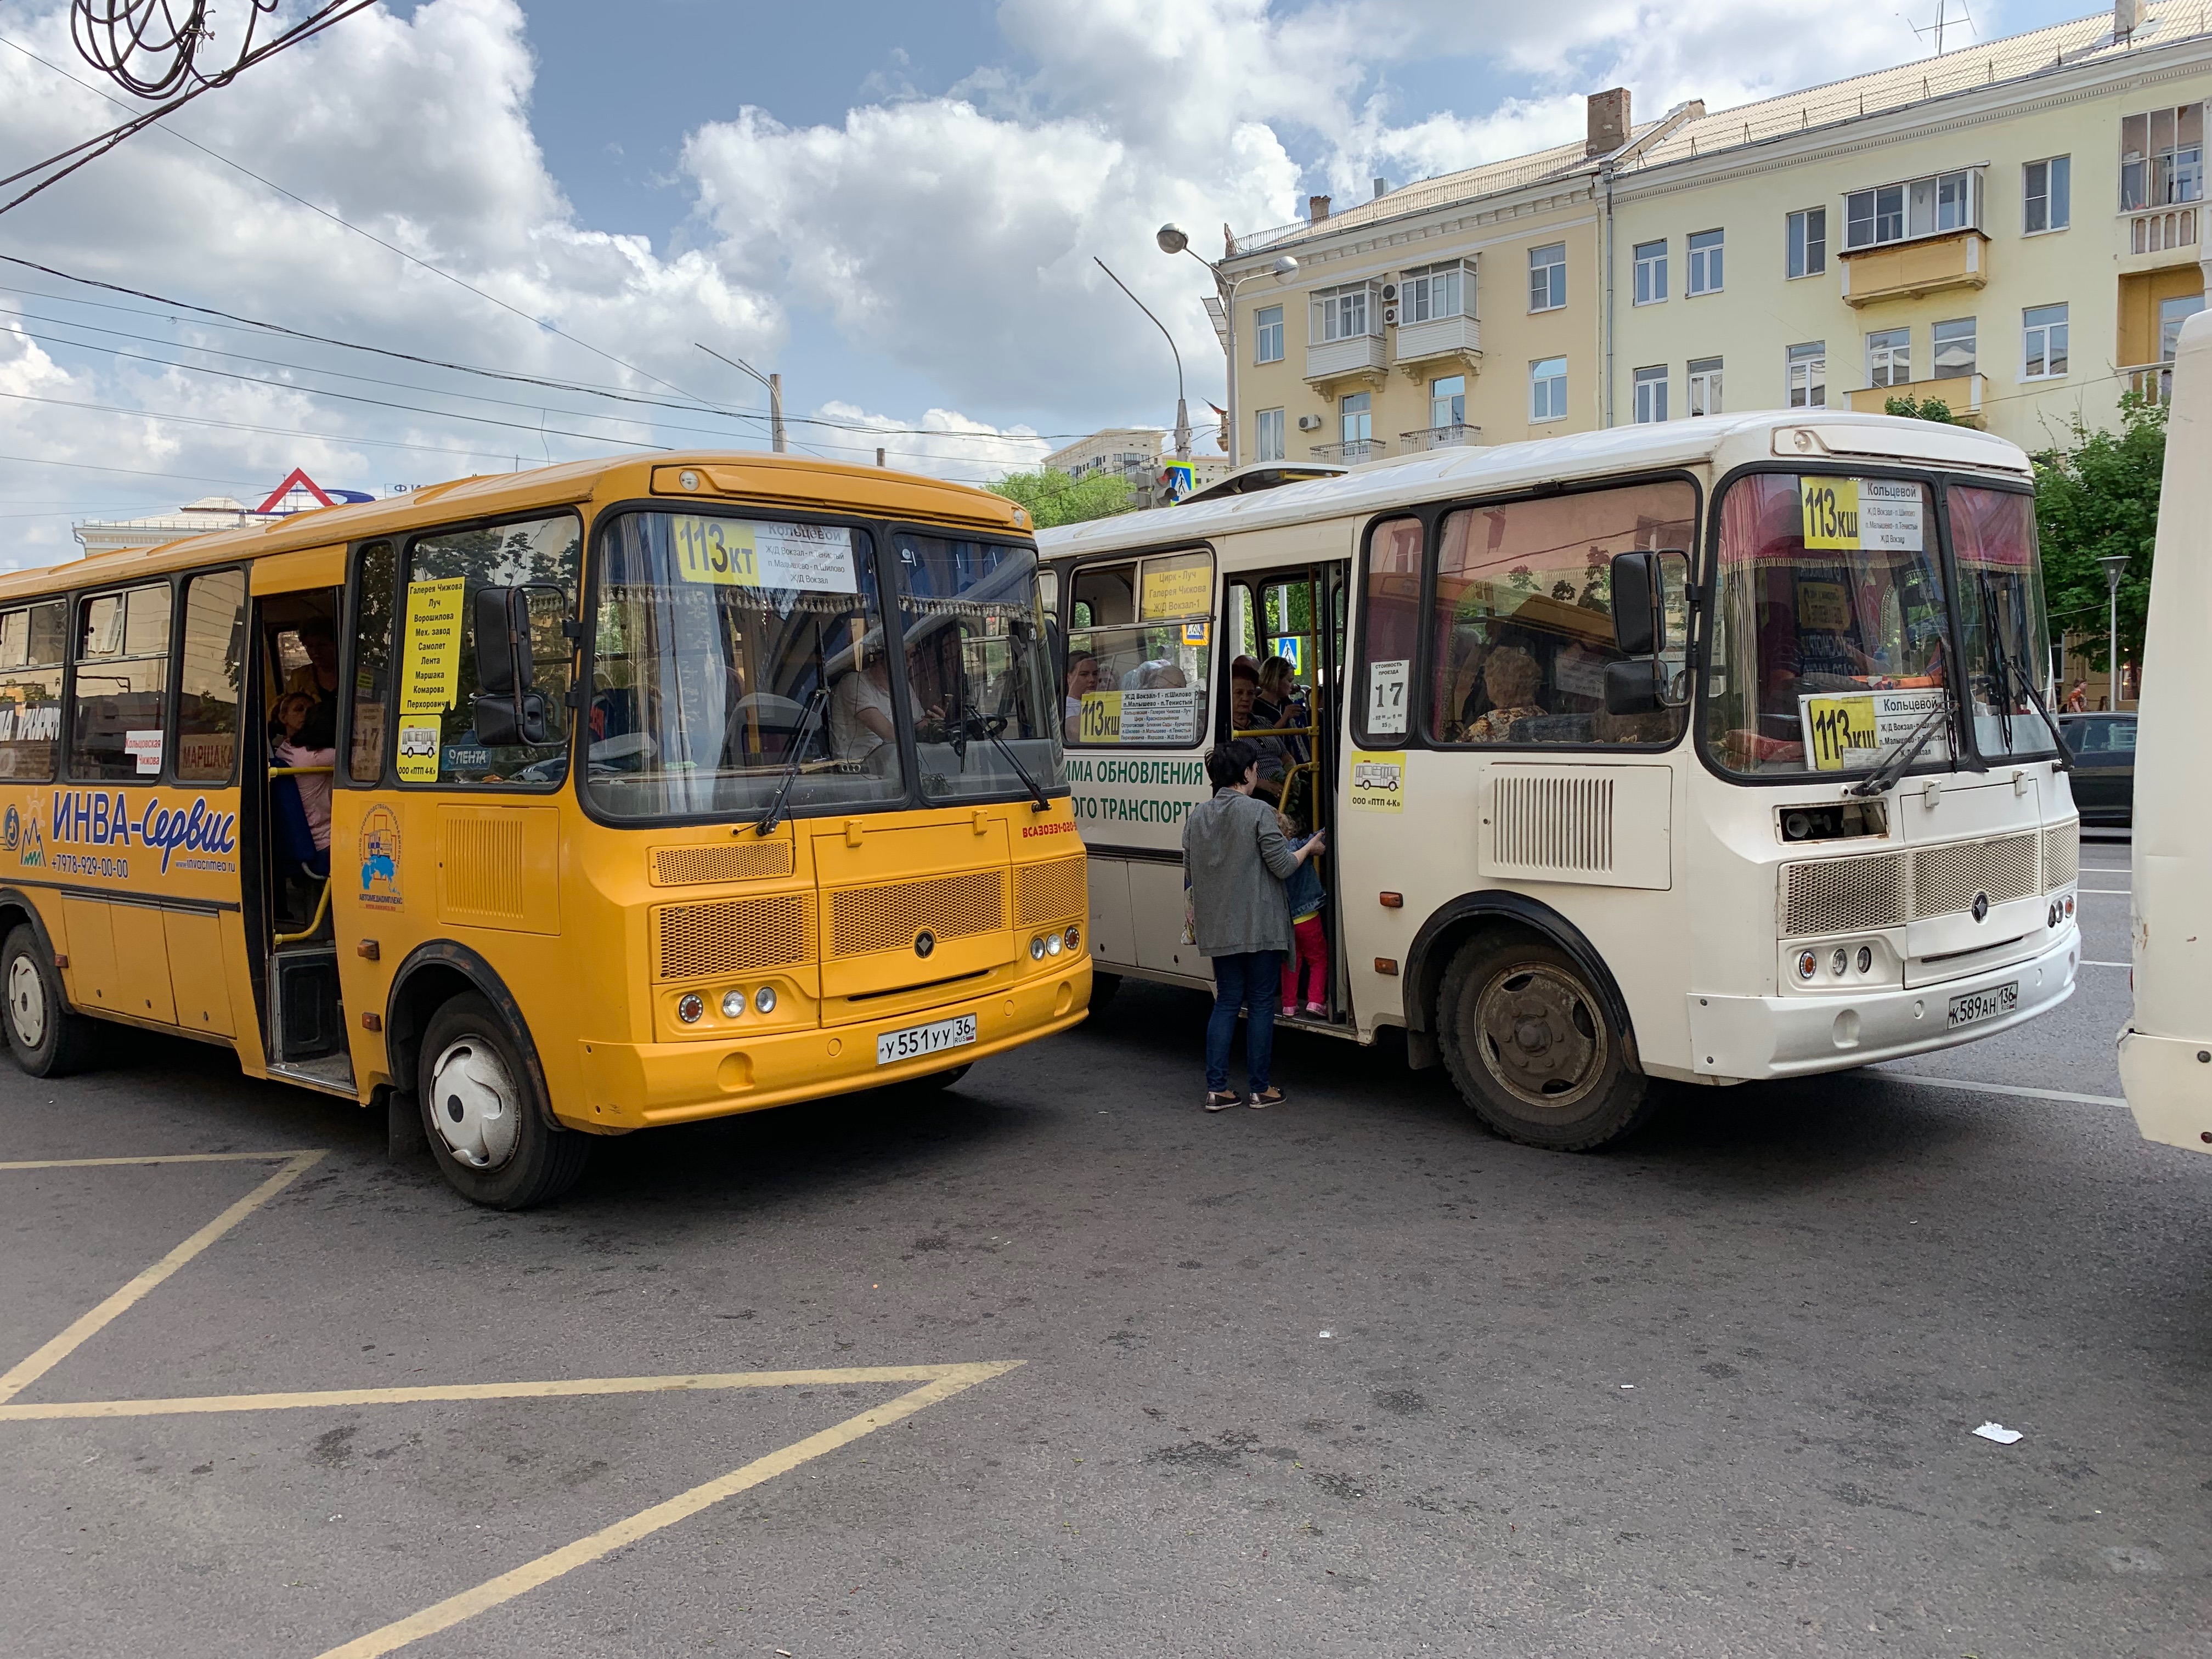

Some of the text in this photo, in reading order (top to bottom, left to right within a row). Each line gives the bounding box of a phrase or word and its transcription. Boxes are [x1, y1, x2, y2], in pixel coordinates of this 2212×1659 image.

[1867, 482, 1916, 498] Кольцевой
[1867, 507, 1876, 516] Ж/Д
[1877, 507, 1893, 516] Вокзал
[769, 522, 841, 541] Кольцевой
[1880, 535, 1905, 544] Ж/Д Вокзал
[766, 545, 780, 556] Ж/Д
[781, 548, 804, 556] Вокзал
[768, 560, 809, 570] п.Малышево
[814, 563, 845, 573] п.Шилово
[791, 574, 828, 584] Ж/Д Вокзал
[1159, 573, 1176, 584] Цирк
[1182, 571, 1196, 582] Луч
[410, 583, 462, 595] Галерея Чижова
[1149, 585, 1206, 599] Галерея Чижова
[428, 599, 441, 609] Луч
[1154, 599, 1199, 613] Ж/Д Вокзал-1
[414, 613, 454, 624] Ворошилова
[415, 628, 450, 637] Мех. завод
[418, 642, 445, 651] Самолет
[421, 656, 441, 665] Лента
[415, 671, 444, 681] Маршака
[413, 685, 444, 695] Комарова
[1375, 682, 1403, 708] 17
[407, 699, 447, 710] Перхорович
[1883, 696, 1937, 712] Кольцевой
[125, 737, 161, 749] Кольцовская
[138, 754, 160, 765] Чижова
[183, 744, 233, 769] МАРШАКА
[456, 750, 486, 765] ЛЕНТА
[398, 766, 409, 775] ООО
[1097, 760, 1203, 786] ОБНОВЛЕНИЯ
[1100, 797, 1200, 823] ТРАНСПОРТ
[53, 792, 235, 874] ИНВА-Сервис
[52, 854, 128, 878] +7978-929-00-00
[359, 893, 403, 905] АВТОМЕДКОМПЛЕКС
[1952, 986, 2013, 1025] К589АН 136
[886, 1018, 970, 1059] У551УУ 36
[955, 1035, 966, 1043] RUS
